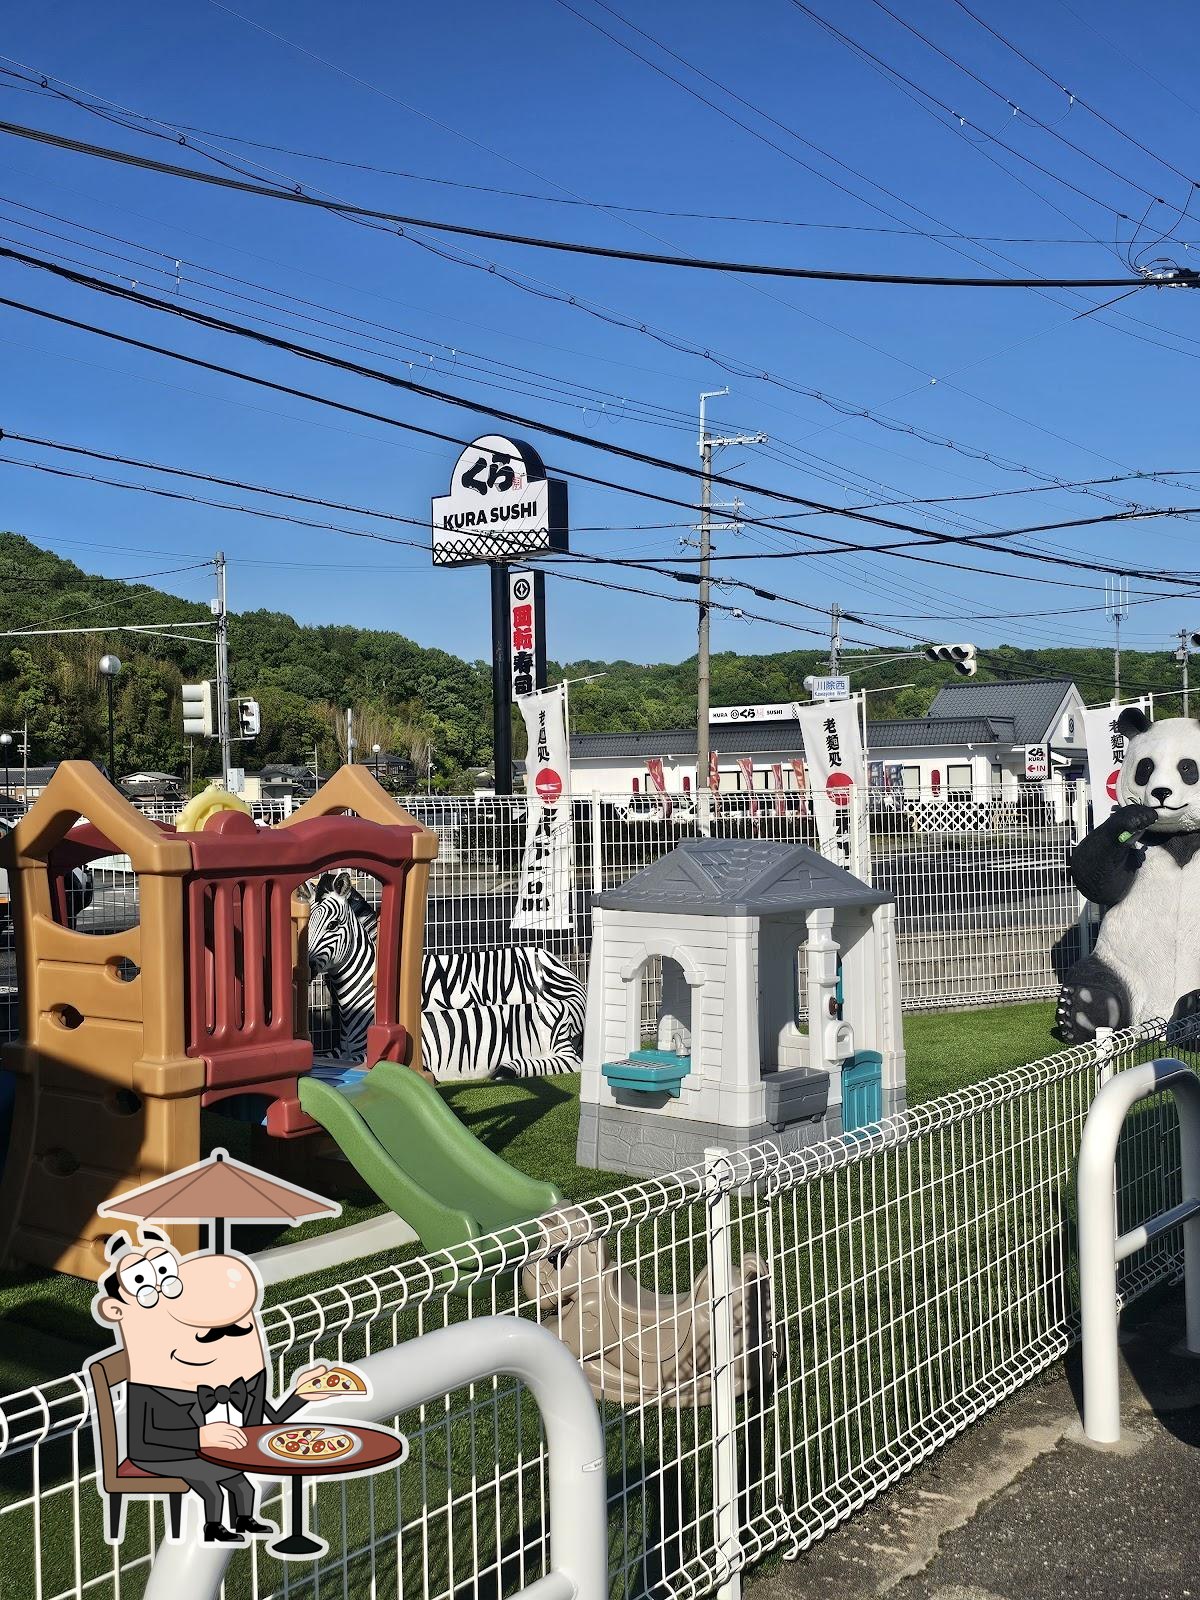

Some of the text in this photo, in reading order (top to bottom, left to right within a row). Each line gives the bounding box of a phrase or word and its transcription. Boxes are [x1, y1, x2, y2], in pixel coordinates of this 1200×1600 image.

[461, 453, 515, 496] くら
[443, 501, 537, 530] KURA SUSHI
[513, 604, 533, 695] 回転寿司
[816, 680, 845, 690] 川除西
[740, 708, 756, 719] くら
[1028, 747, 1044, 757] くら
